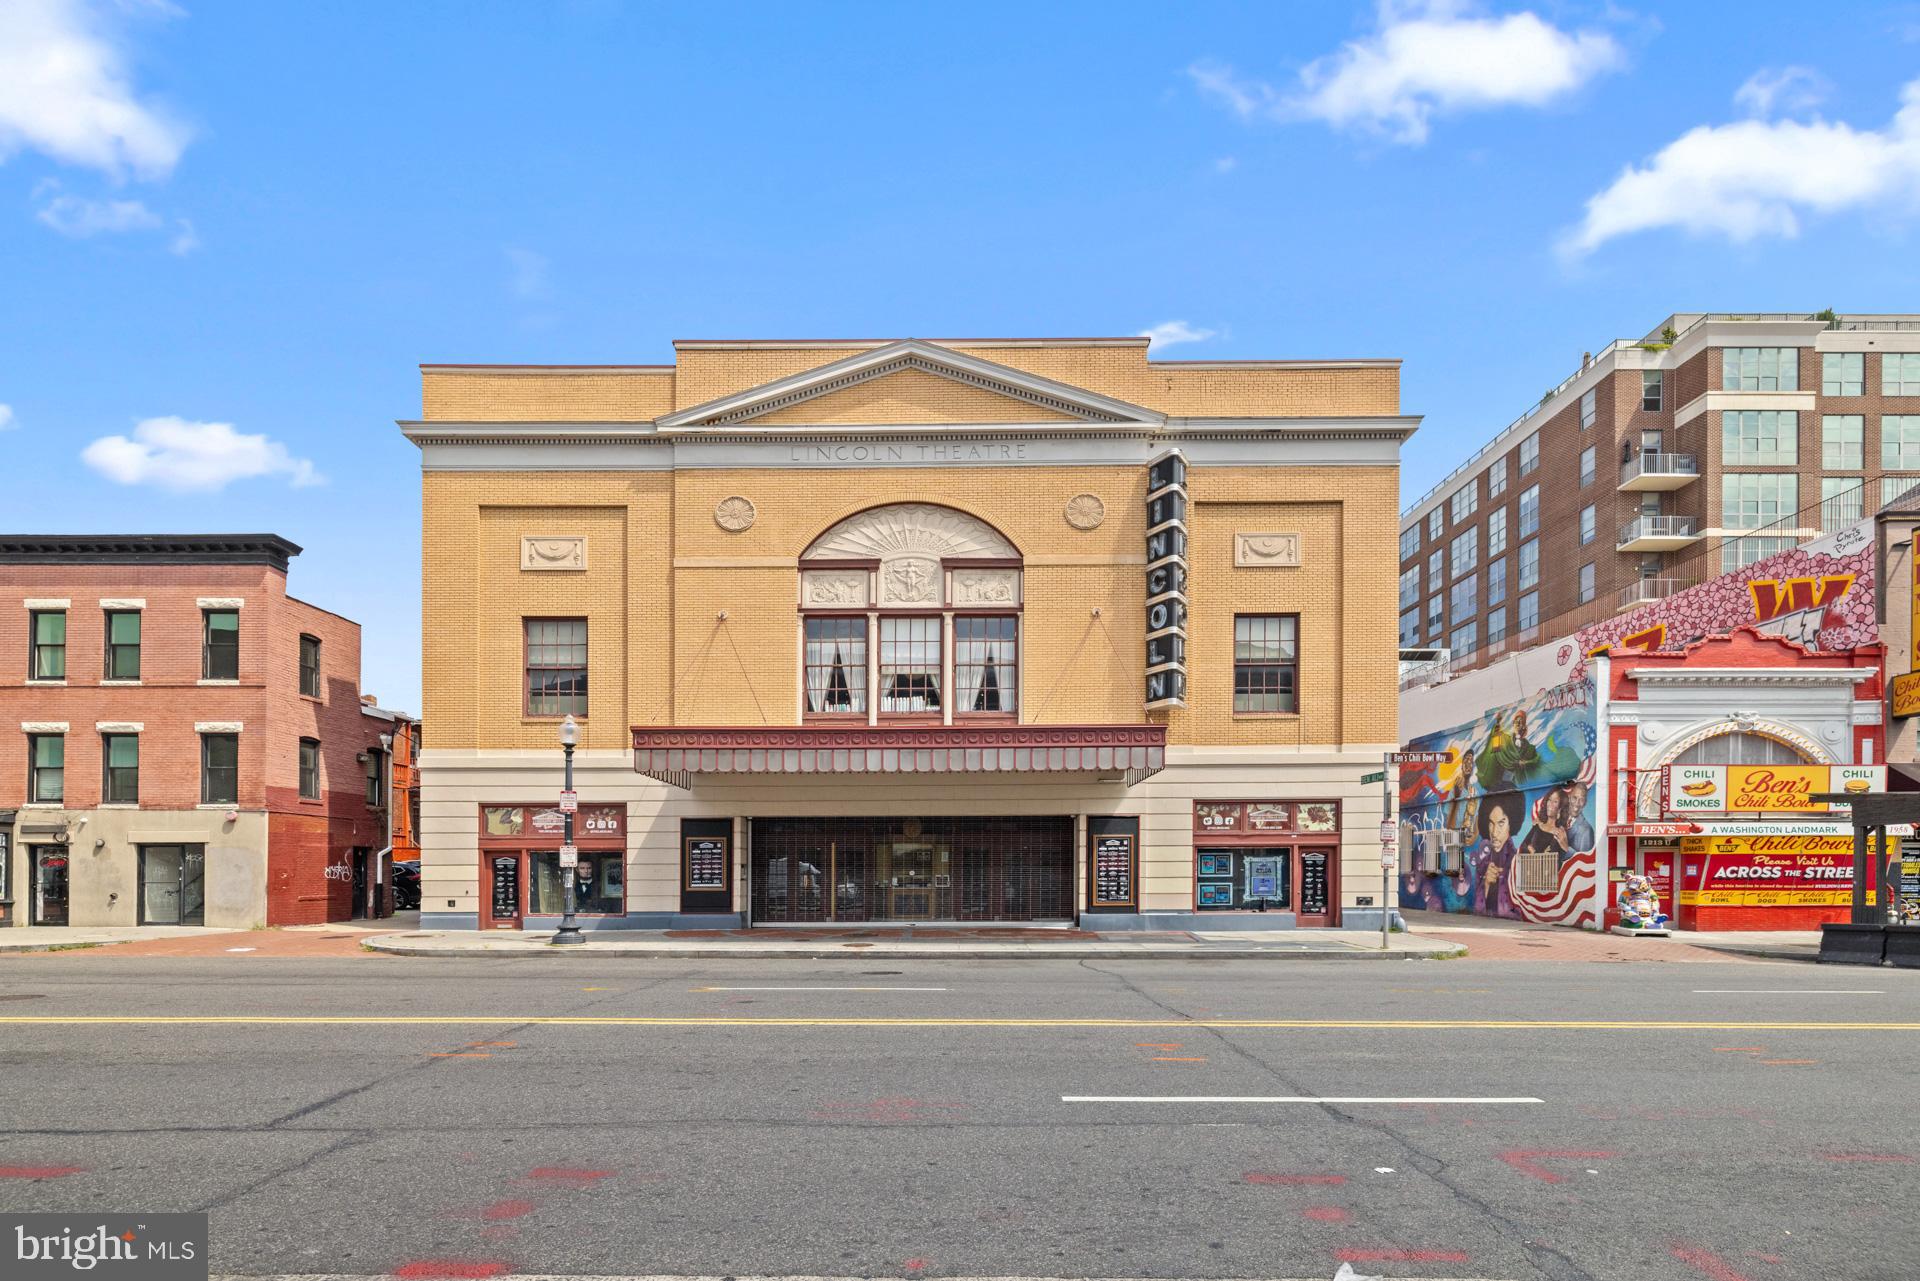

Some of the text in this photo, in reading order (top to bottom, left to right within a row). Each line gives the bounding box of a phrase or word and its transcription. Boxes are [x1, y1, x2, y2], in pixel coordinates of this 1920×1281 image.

[790, 444, 1026, 461] LINCOLN THEATRE
[1150, 466, 1167, 699] LINCOLN
[1394, 753, 1446, 763] Ben's Chili Bowl Way
[1684, 770, 1715, 778] CHILI
[1842, 770, 1873, 778] CHILI
[1741, 770, 1811, 793] Ben's
[1676, 799, 1720, 807] SMOKES
[1734, 793, 1769, 807] Chili
[1721, 826, 1782, 834] WASHINGTON
[1750, 835, 1801, 850] Chili
[1803, 835, 1854, 850] Bowl
[1753, 855, 1834, 865] Please Visit Us
[1714, 866, 1782, 878] ACROSS
[1804, 867, 1853, 878] STREE
